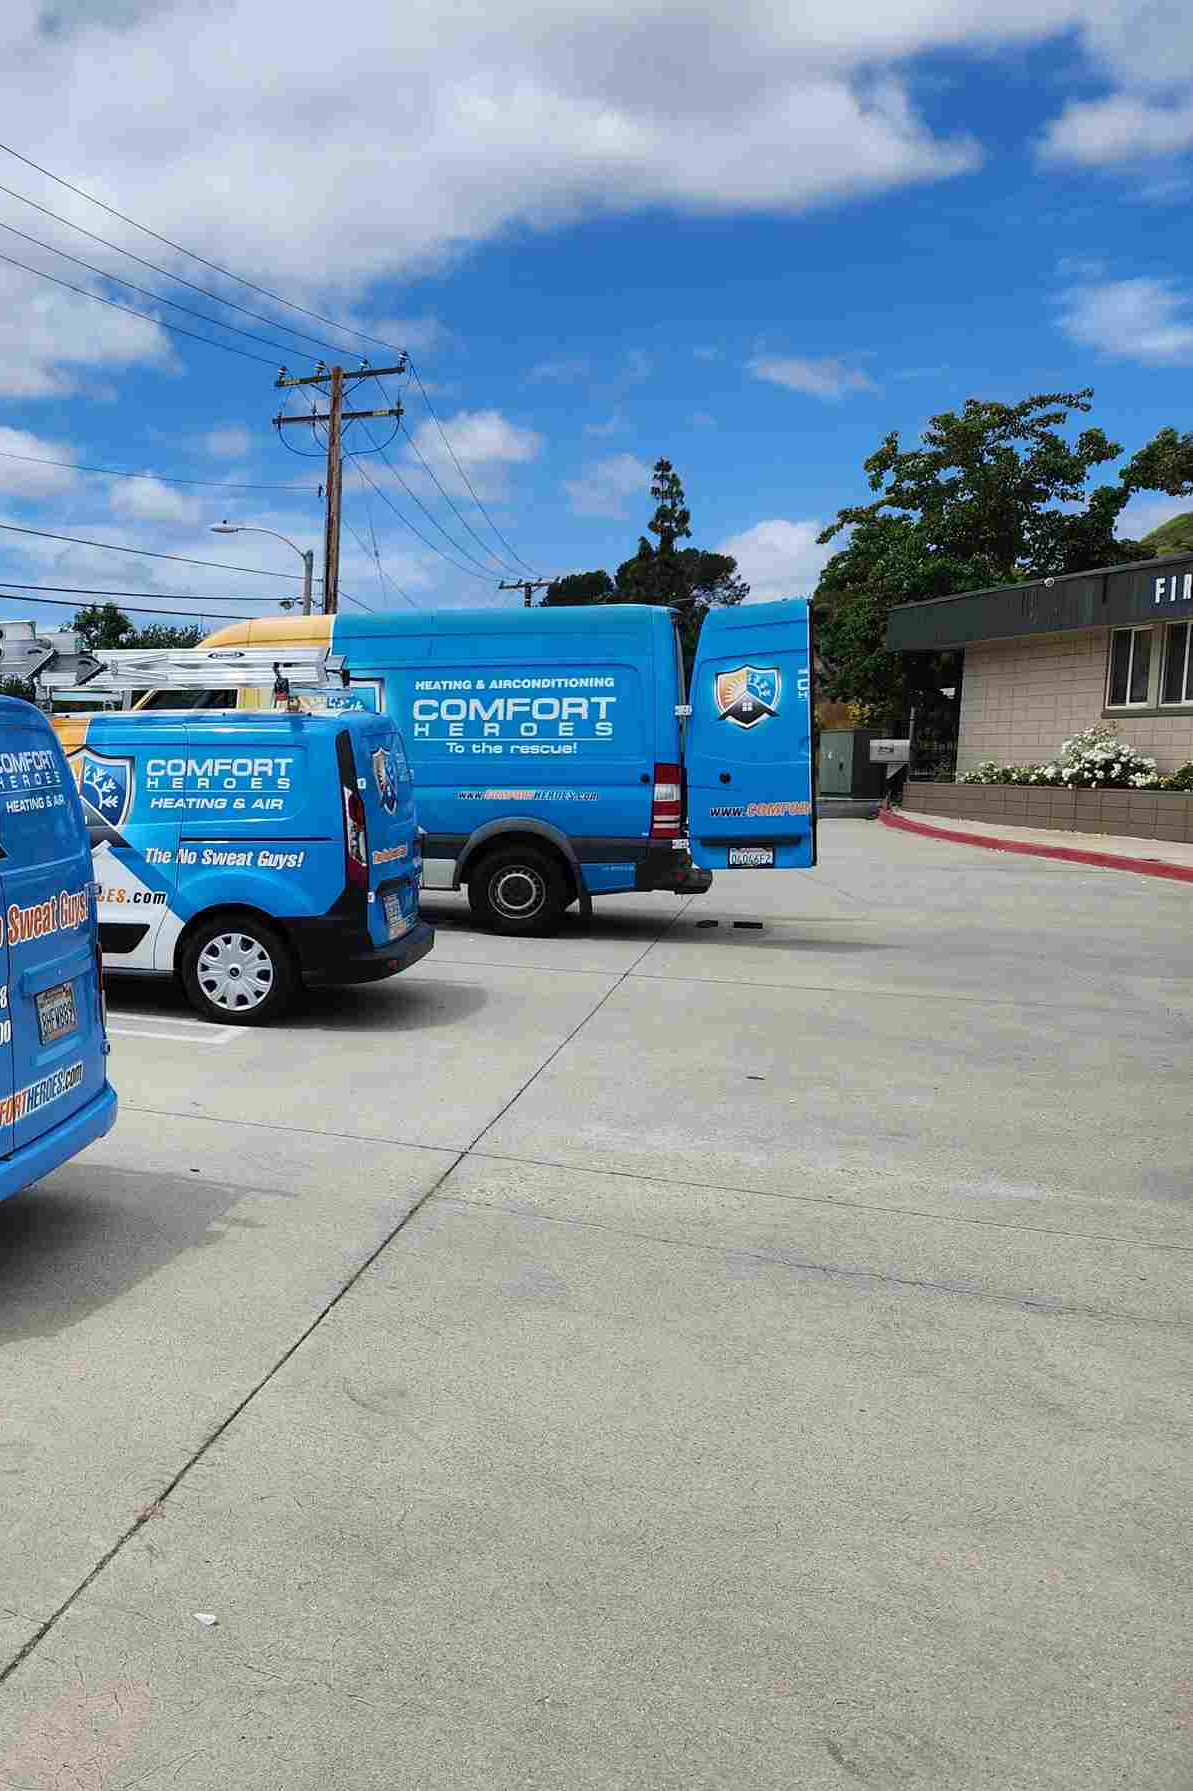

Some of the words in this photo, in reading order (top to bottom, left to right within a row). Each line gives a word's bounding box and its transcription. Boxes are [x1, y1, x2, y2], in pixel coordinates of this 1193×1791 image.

[414, 679, 472, 690] HEATING
[476, 679, 486, 690] &
[489, 677, 615, 690] AIRCONDITIONING
[412, 696, 617, 722] COMFORT
[413, 721, 614, 737] HEROES
[445, 742, 465, 754] To
[471, 742, 503, 754] the
[509, 742, 579, 755] rescue!
[146, 757, 295, 777] COMFORT
[146, 777, 291, 790] HEROES
[150, 797, 228, 810] HEATING
[233, 798, 246, 810] &
[251, 798, 284, 811] AIR
[144, 847, 172, 865] The
[176, 848, 197, 865] No
[201, 848, 254, 867] Sweat
[257, 850, 305, 870] Guys!
[6, 895, 58, 946] Sweat
